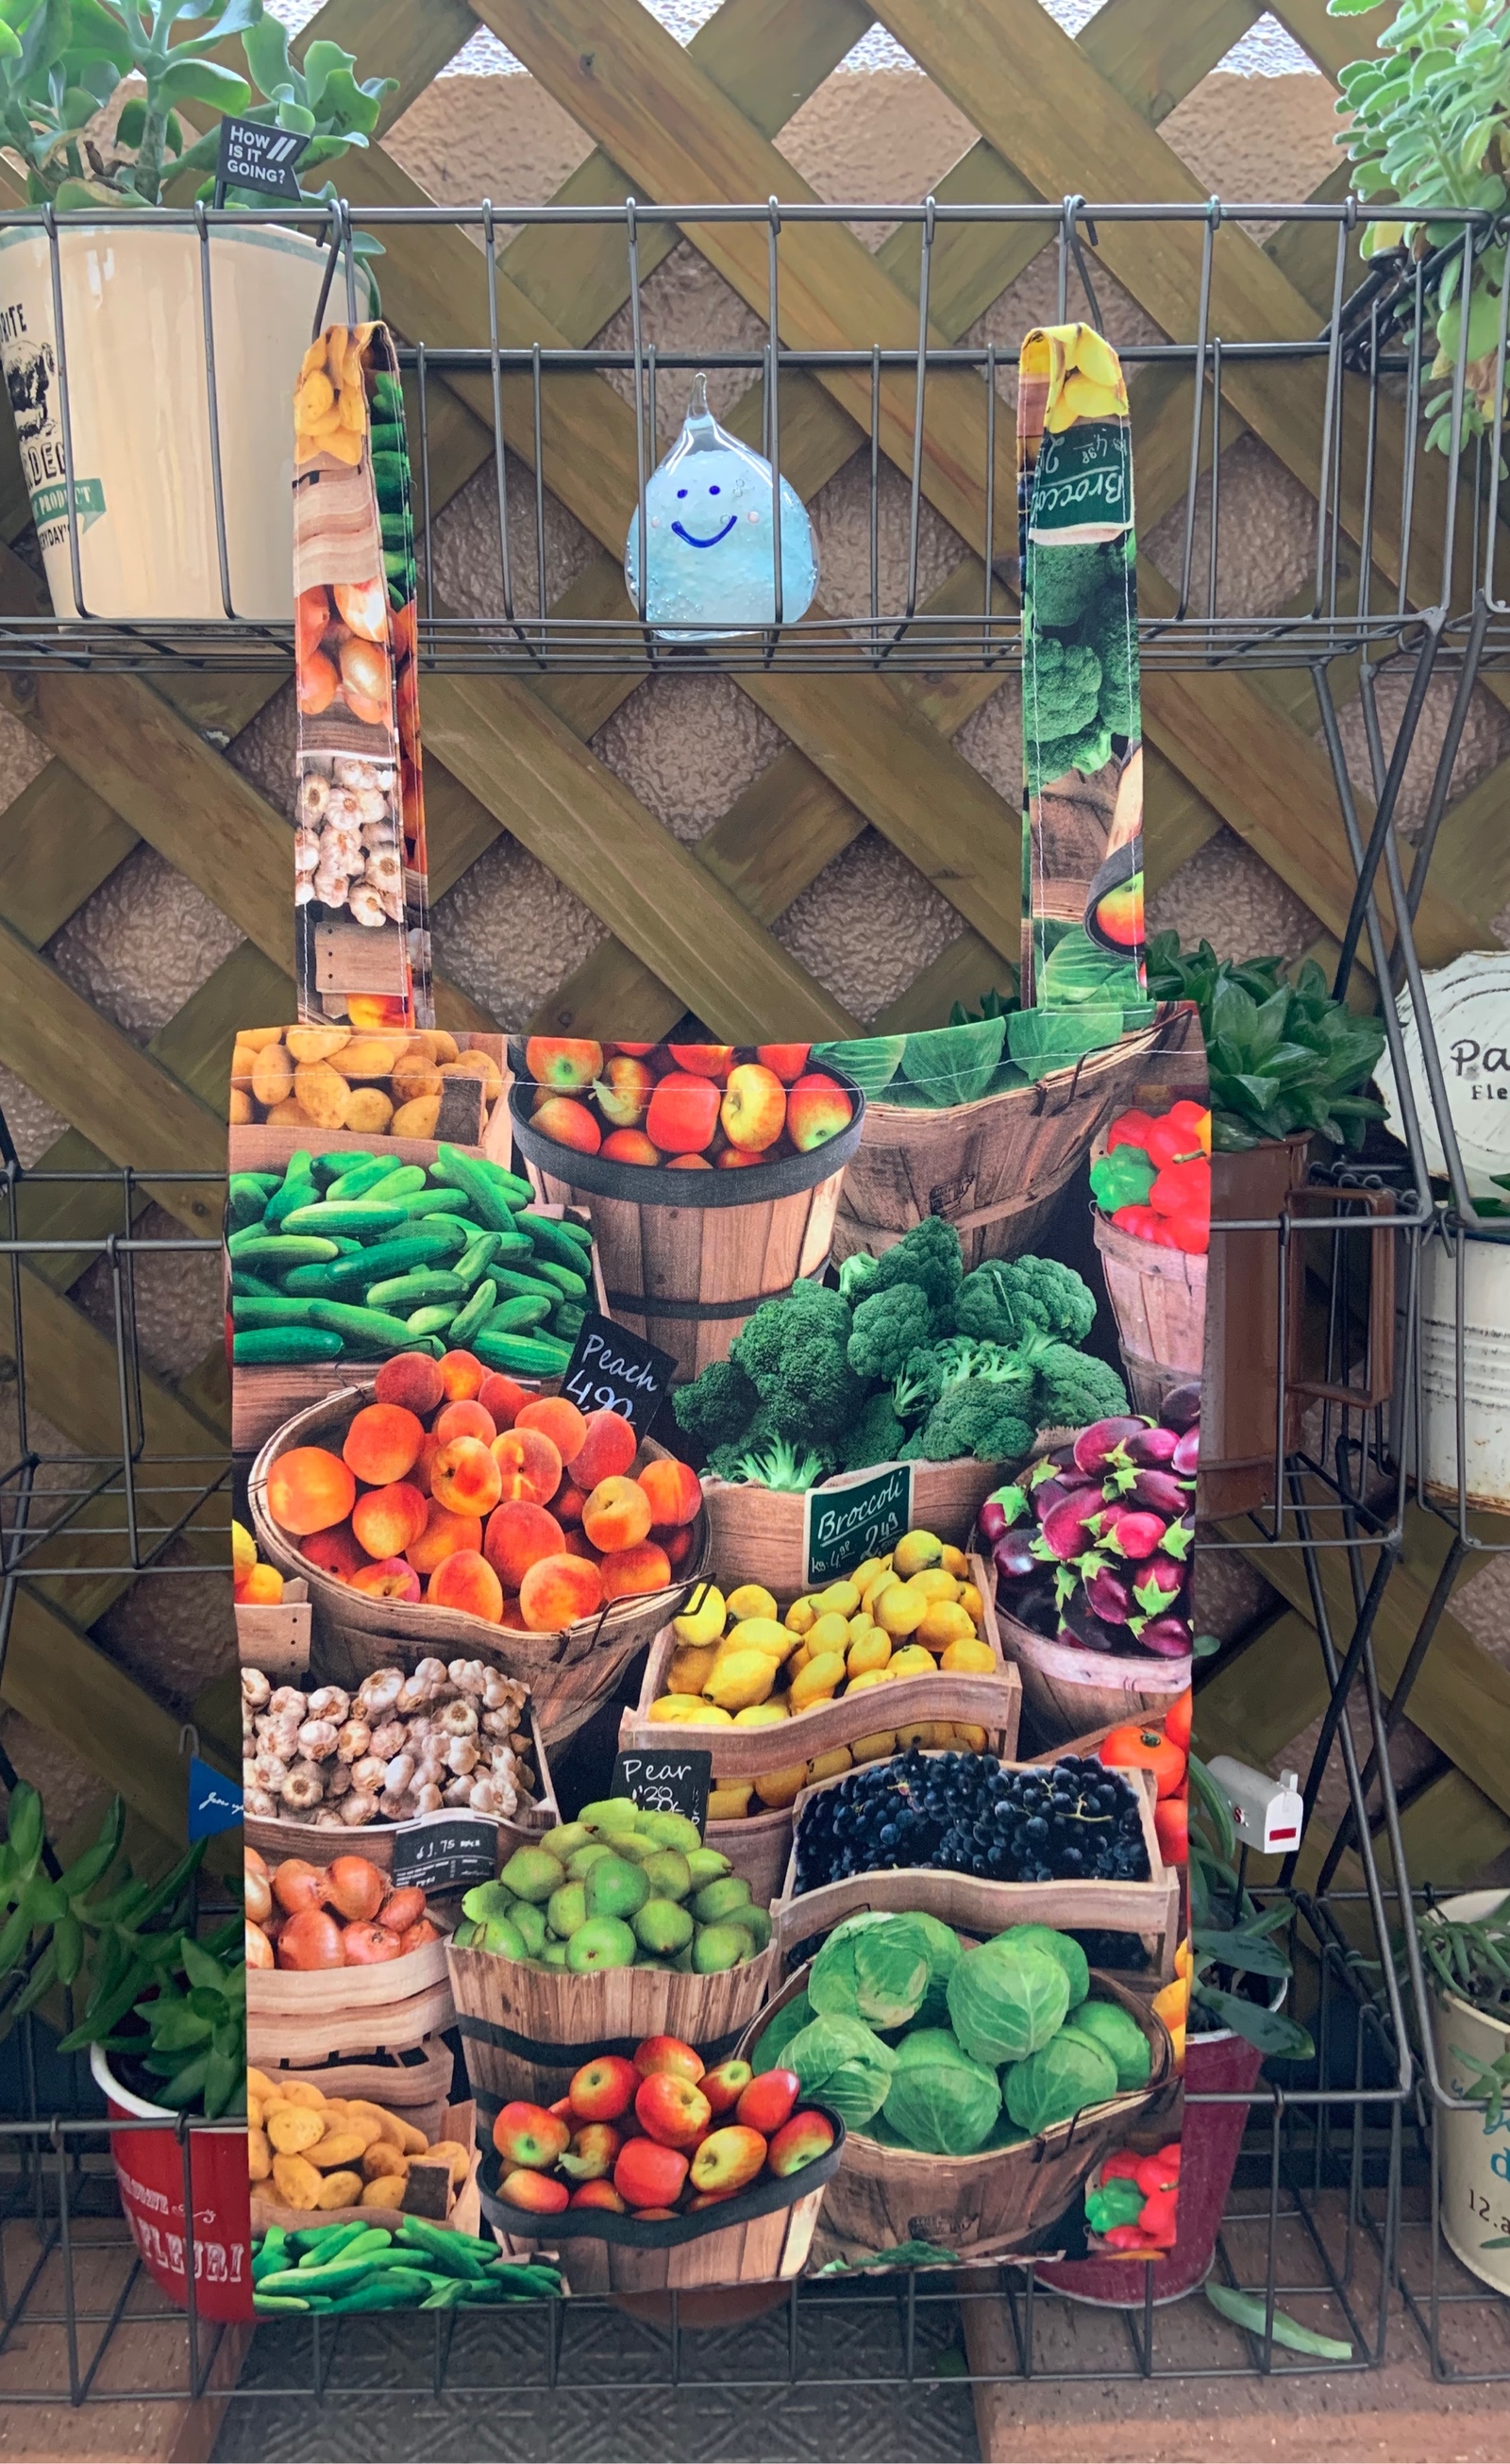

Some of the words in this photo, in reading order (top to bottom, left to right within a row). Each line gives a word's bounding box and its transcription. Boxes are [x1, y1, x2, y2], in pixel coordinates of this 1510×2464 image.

[228, 142, 243, 159] IS
[247, 147, 262, 163] IT
[226, 159, 286, 185] GOING?
[581, 1333, 659, 1392] Peach
[817, 1470, 903, 1541] Broccoli
[623, 1759, 692, 1783] Pear
